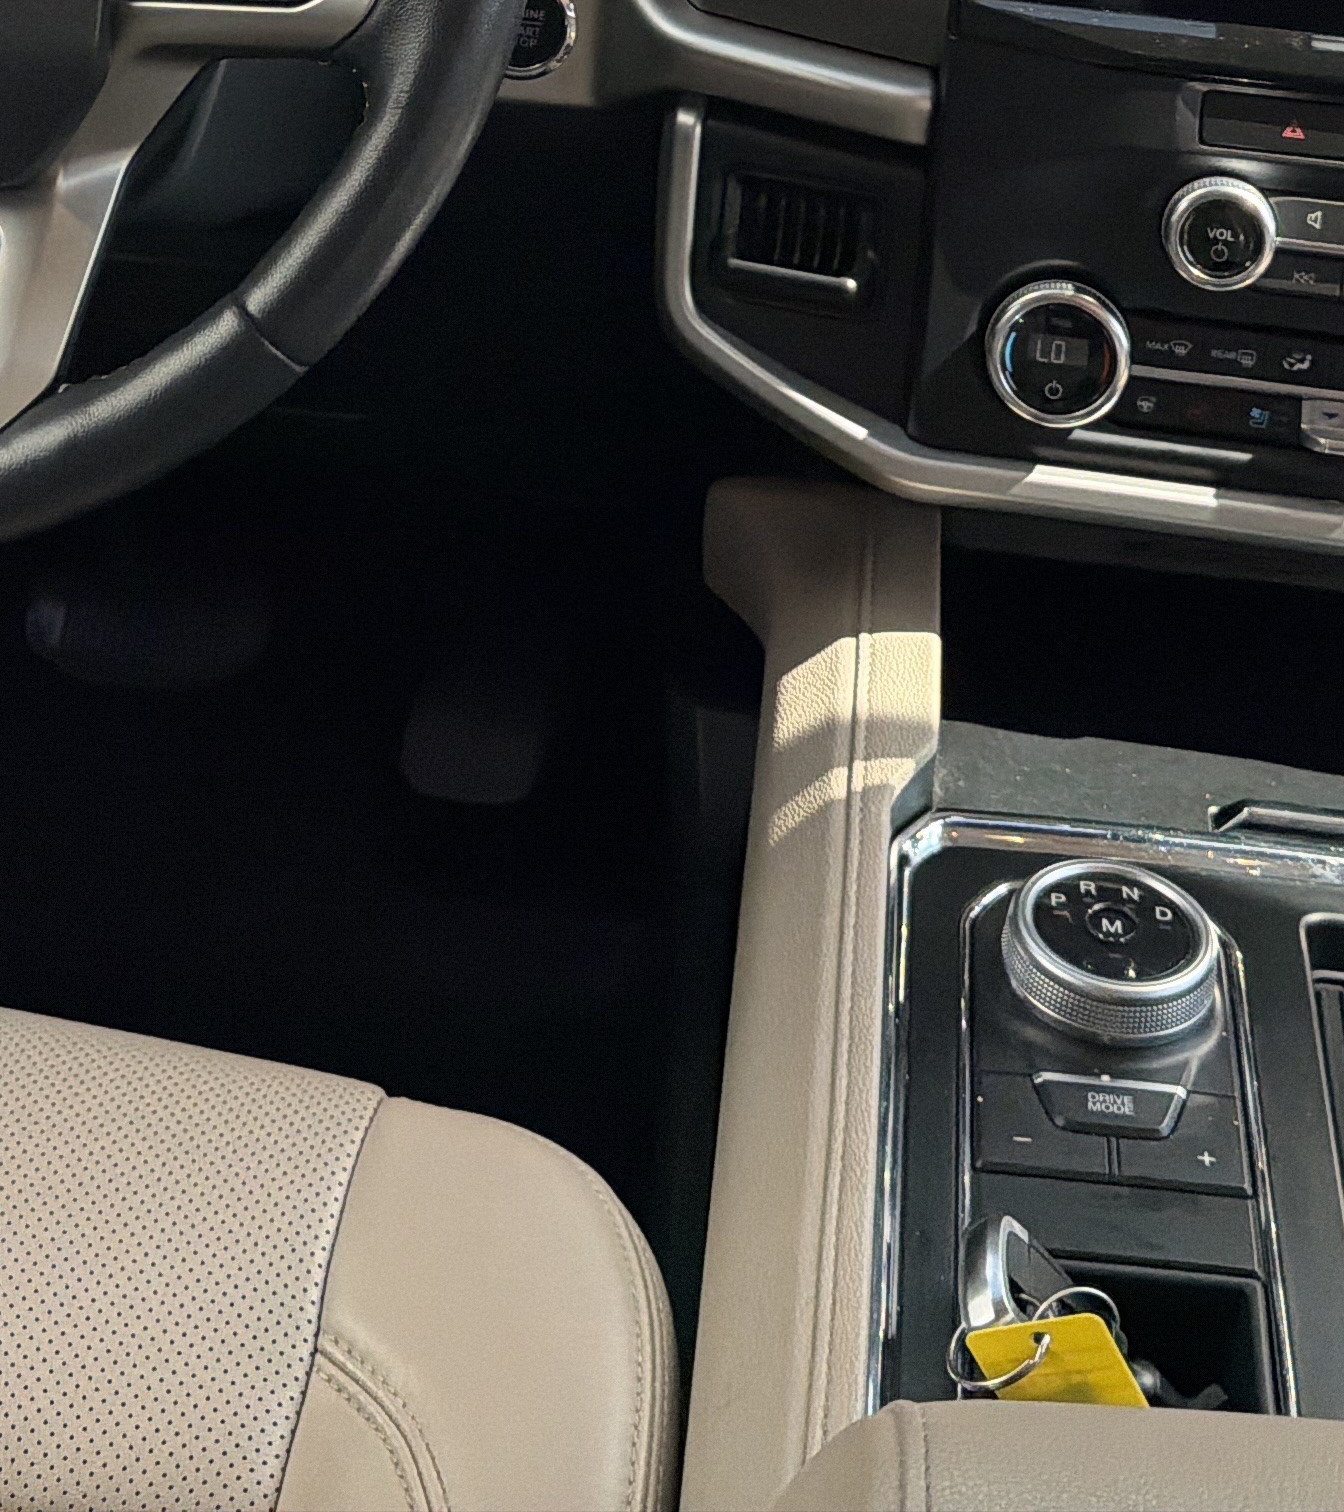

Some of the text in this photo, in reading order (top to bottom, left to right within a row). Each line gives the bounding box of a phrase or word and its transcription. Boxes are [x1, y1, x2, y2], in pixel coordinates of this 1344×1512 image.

[1207, 227, 1235, 242] VOL
[1079, 880, 1097, 896] R
[1121, 885, 1140, 902] N
[1050, 892, 1067, 907] P
[1154, 905, 1173, 921] D
[1101, 917, 1123, 935] M
[1087, 1091, 1134, 1106] DRIVE
[1087, 1102, 1135, 1116] MODE
